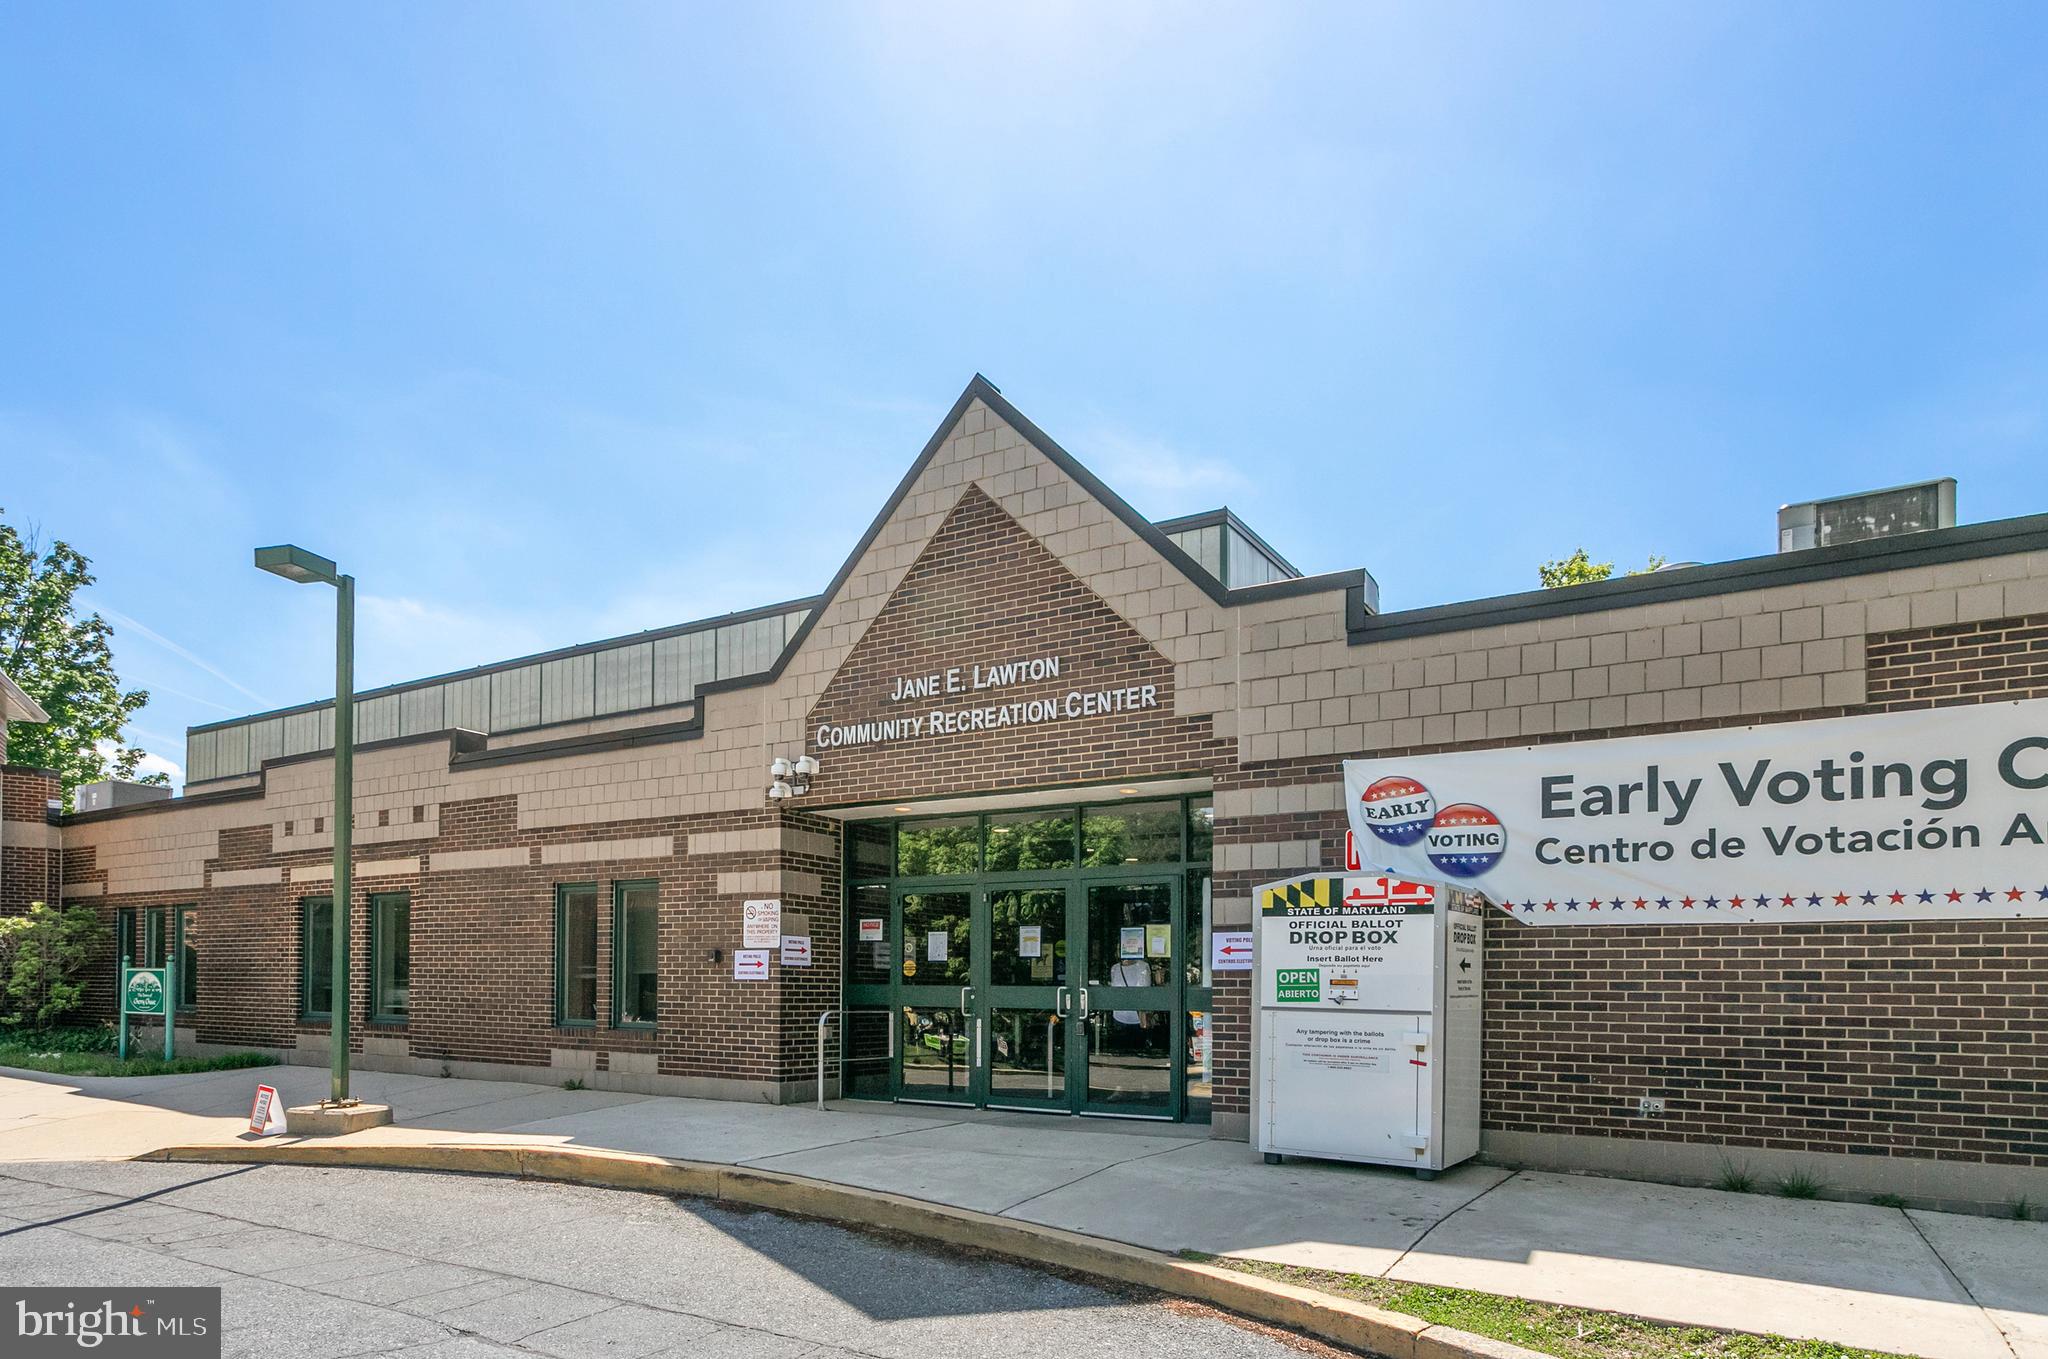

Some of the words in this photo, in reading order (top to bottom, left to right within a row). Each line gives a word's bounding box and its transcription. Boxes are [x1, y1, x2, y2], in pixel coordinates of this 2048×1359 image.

[890, 677, 941, 701] JANE
[946, 667, 966, 693] E.
[973, 656, 1060, 689] LAWTON
[816, 716, 922, 748] COMMUNITY
[929, 699, 1058, 735] RECREATION
[1065, 685, 1159, 718] CENTER
[1541, 765, 1703, 826] Early
[1718, 751, 1968, 811] Voting
[1365, 798, 1431, 821] EARLY
[1428, 832, 1500, 848] VOTING
[1535, 838, 1675, 865] Centro
[1690, 828, 1746, 860] de
[1762, 817, 1980, 857] Votación
[1999, 813, 2048, 846] A
[1288, 907, 1320, 916] STATE
[1324, 907, 1339, 916] OF
[1342, 906, 1406, 915] MARYLAND
[1289, 920, 1347, 929] OFFICIAL
[1352, 920, 1404, 929] BALLOT
[1290, 931, 1348, 944] DROP
[1352, 930, 1398, 944] BOX
[1453, 932, 1466, 944] DROP
[1467, 933, 1477, 944] BOX
[1279, 971, 1318, 984] OPEN
[1278, 990, 1319, 998] ABIERTO
[1296, 1028, 1309, 1036] Any
[1310, 1029, 1338, 1037] tampering
[1315, 1036, 1329, 1044] drop
